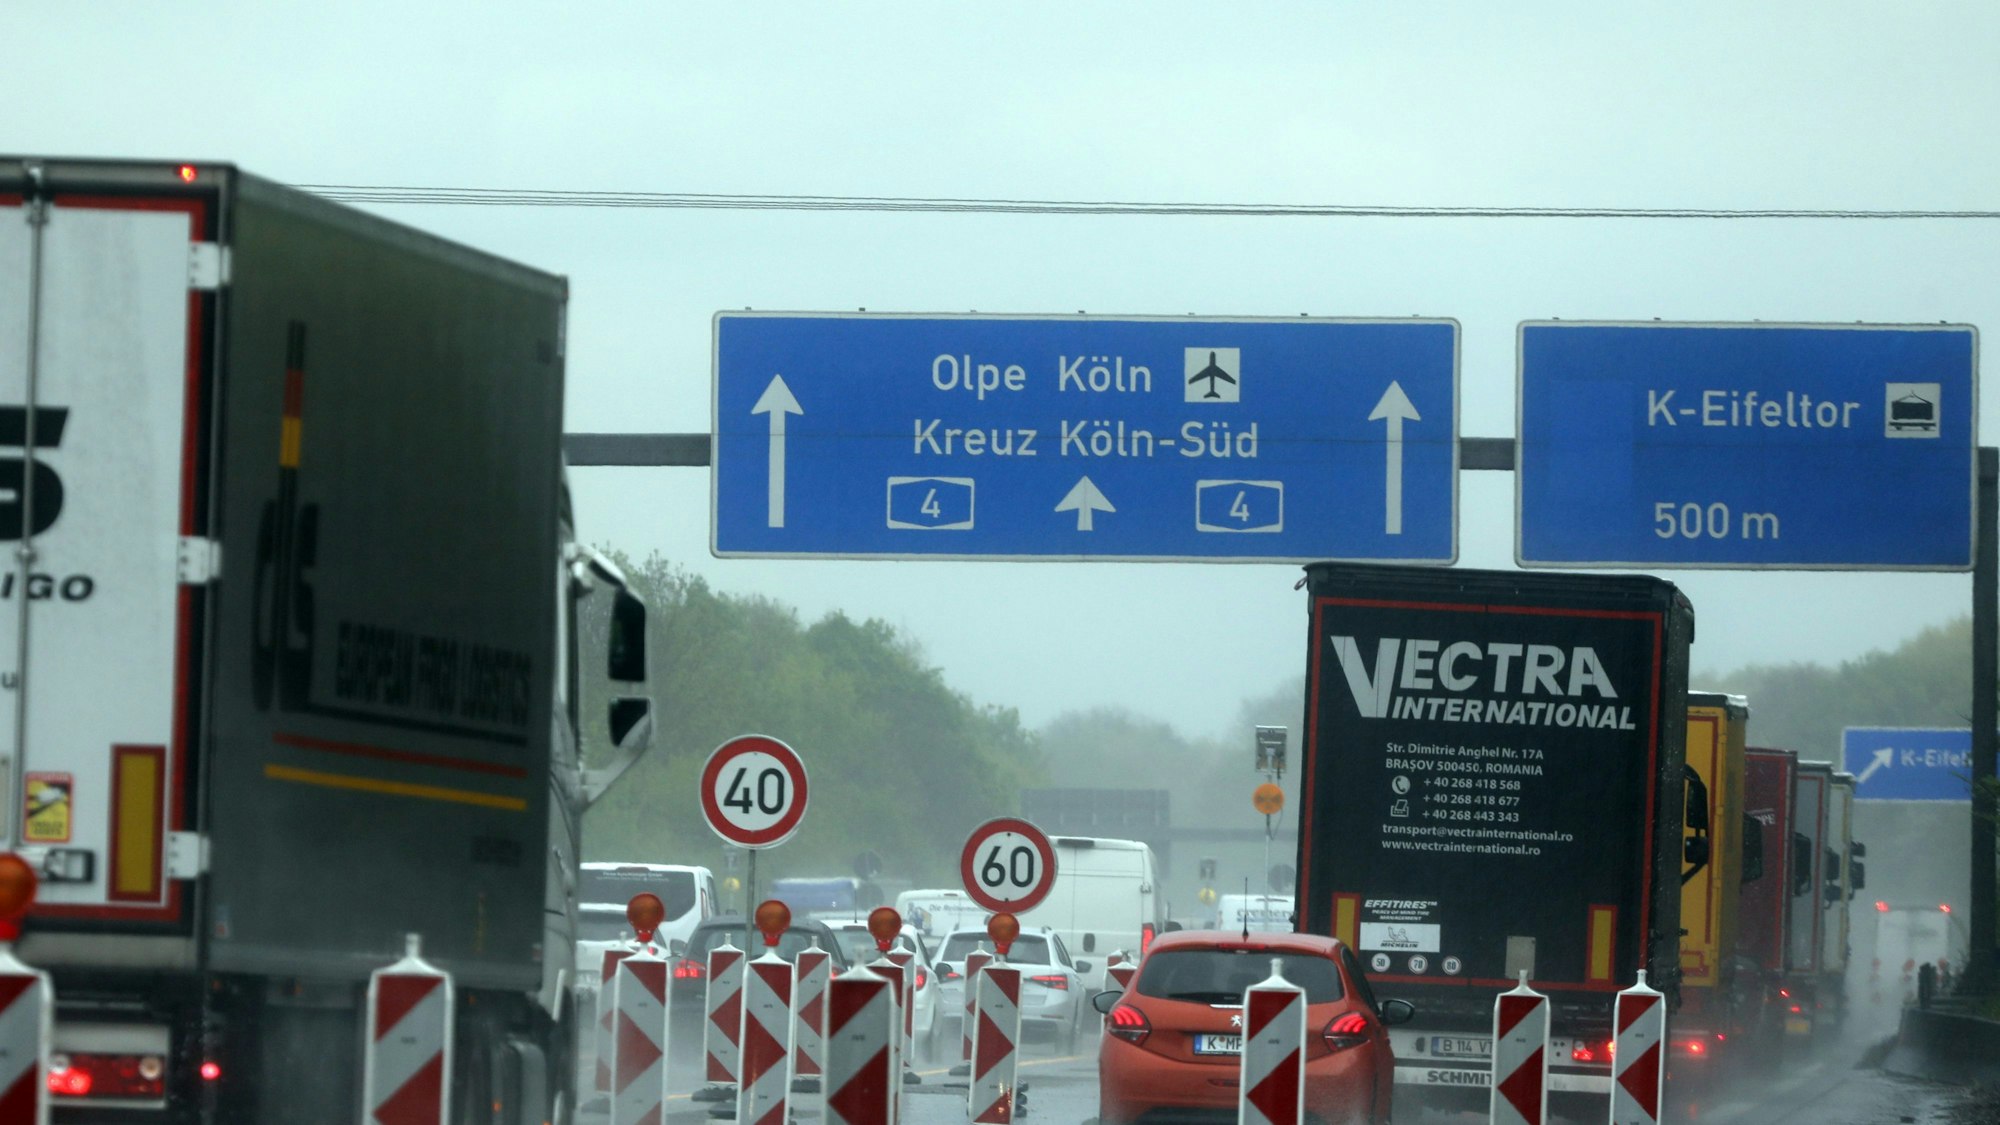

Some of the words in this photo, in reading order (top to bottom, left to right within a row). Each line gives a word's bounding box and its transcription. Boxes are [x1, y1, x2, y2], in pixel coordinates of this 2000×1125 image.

[932, 354, 1026, 400] Olpe
[1058, 355, 1151, 392] Köln
[1647, 389, 1860, 428] K-Eifeltor
[914, 418, 1038, 456] Kreuz
[1060, 420, 1258, 458] Köln-Süd
[920, 488, 941, 519] 4
[1229, 491, 1250, 522] 4
[1654, 502, 1730, 539] 500
[1741, 510, 1780, 539] m
[1330, 635, 1618, 718] VECTRA
[1392, 695, 1636, 731] INTERNATIONAL
[1386, 742, 1406, 753] Str.
[1408, 743, 1456, 756] Dimitrie
[1458, 745, 1500, 760] Anghel
[1502, 748, 1518, 759] Nr.
[1522, 749, 1544, 760] 17A
[1901, 748, 1974, 768] K-Eifel
[1437, 760, 1482, 773] 500450,
[1485, 763, 1543, 776] ROMANIA
[723, 767, 786, 816] 40
[1434, 777, 1449, 787] 40
[1451, 777, 1473, 789] 268
[1475, 778, 1497, 790] 418
[1499, 779, 1521, 791] 568
[1433, 793, 1448, 803] 40
[1450, 793, 1472, 805] 268
[1474, 794, 1496, 806] 418
[1498, 795, 1520, 807] 677
[1432, 809, 1447, 819] 40
[1449, 809, 1471, 821] 268
[1473, 810, 1495, 822] 443
[1498, 811, 1519, 823] 343
[1382, 824, 1574, 842] transport@vectrainternational.ro
[1381, 839, 1541, 855] www.vectrainternational.ro
[981, 845, 1035, 888] 60
[1376, 958, 1386, 967] 50
[1413, 959, 1423, 969] 70
[1207, 1036, 1217, 1050] K
[1443, 1039, 1452, 1051] B
[1457, 1040, 1472, 1053] 114
